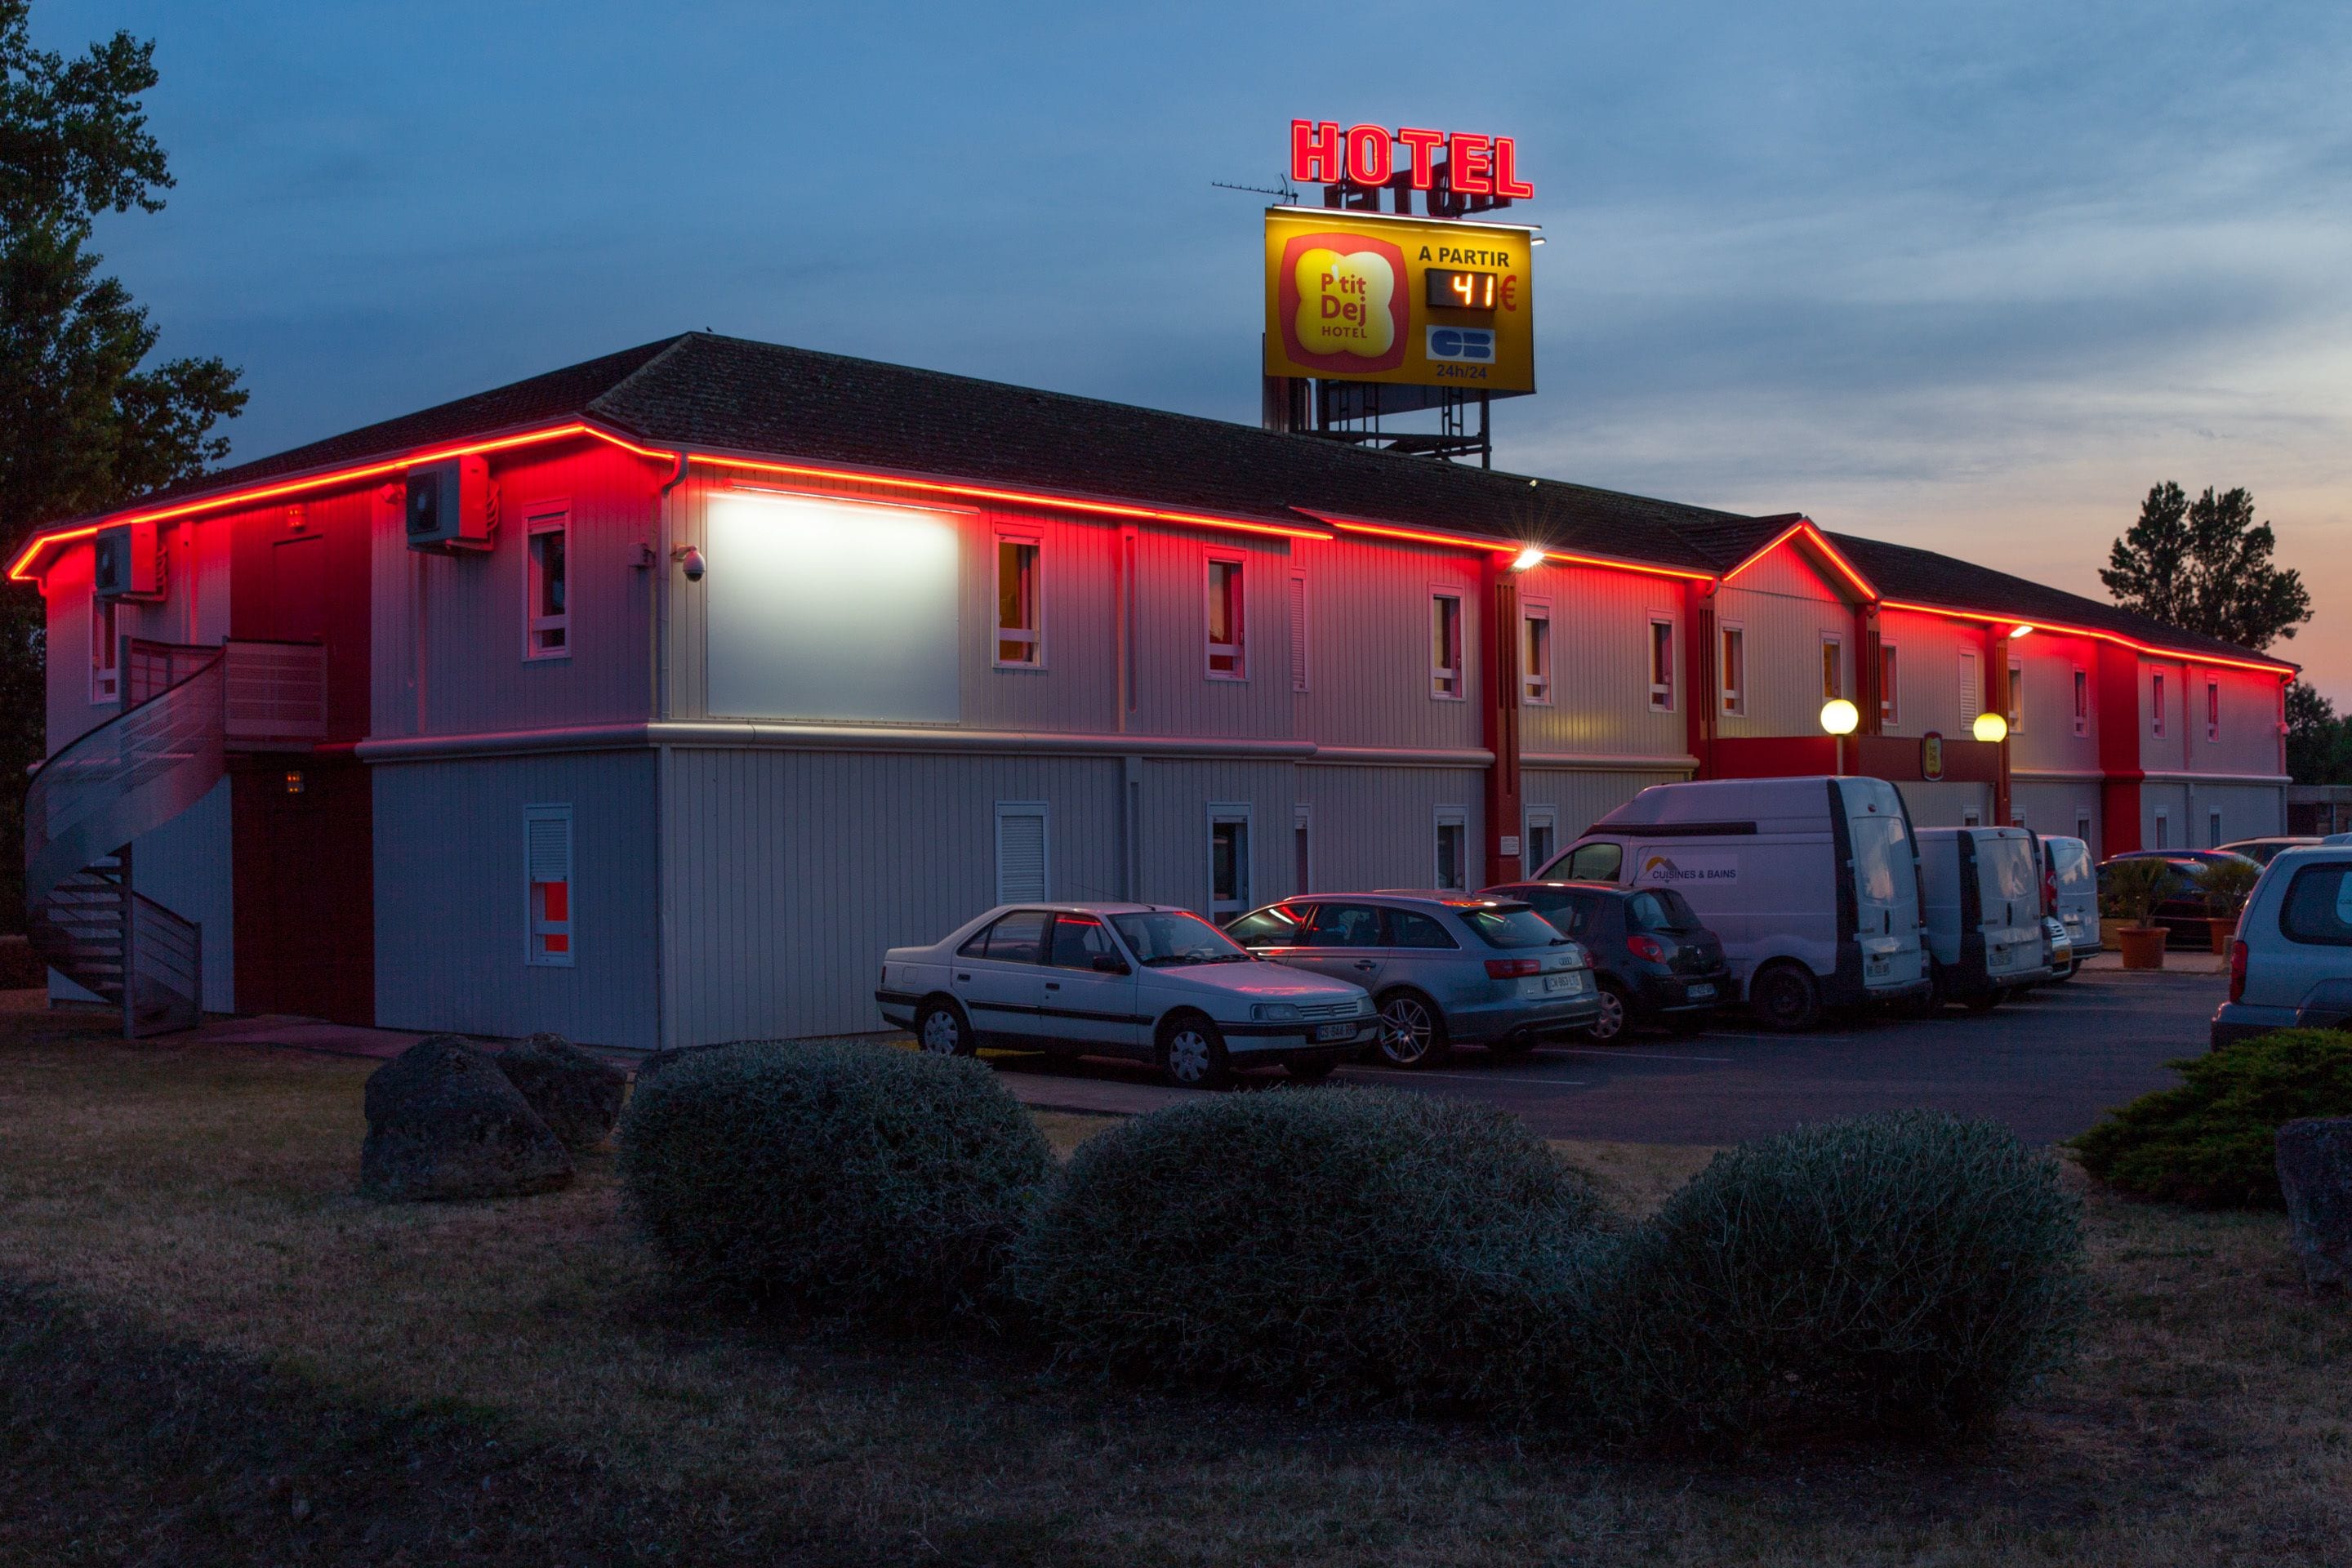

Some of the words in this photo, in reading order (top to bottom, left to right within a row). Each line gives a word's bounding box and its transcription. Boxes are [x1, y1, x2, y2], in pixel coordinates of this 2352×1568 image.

[1291, 119, 1533, 198] HOTEL
[1419, 245, 1432, 261] A
[1438, 247, 1509, 267] PARTIR
[1321, 295, 1366, 327] Dej
[1321, 326, 1367, 339] HOTEL
[1437, 364, 1489, 380] 24h/24
[1652, 870, 1696, 880] CUISINES
[1707, 869, 1736, 879] BAINS
